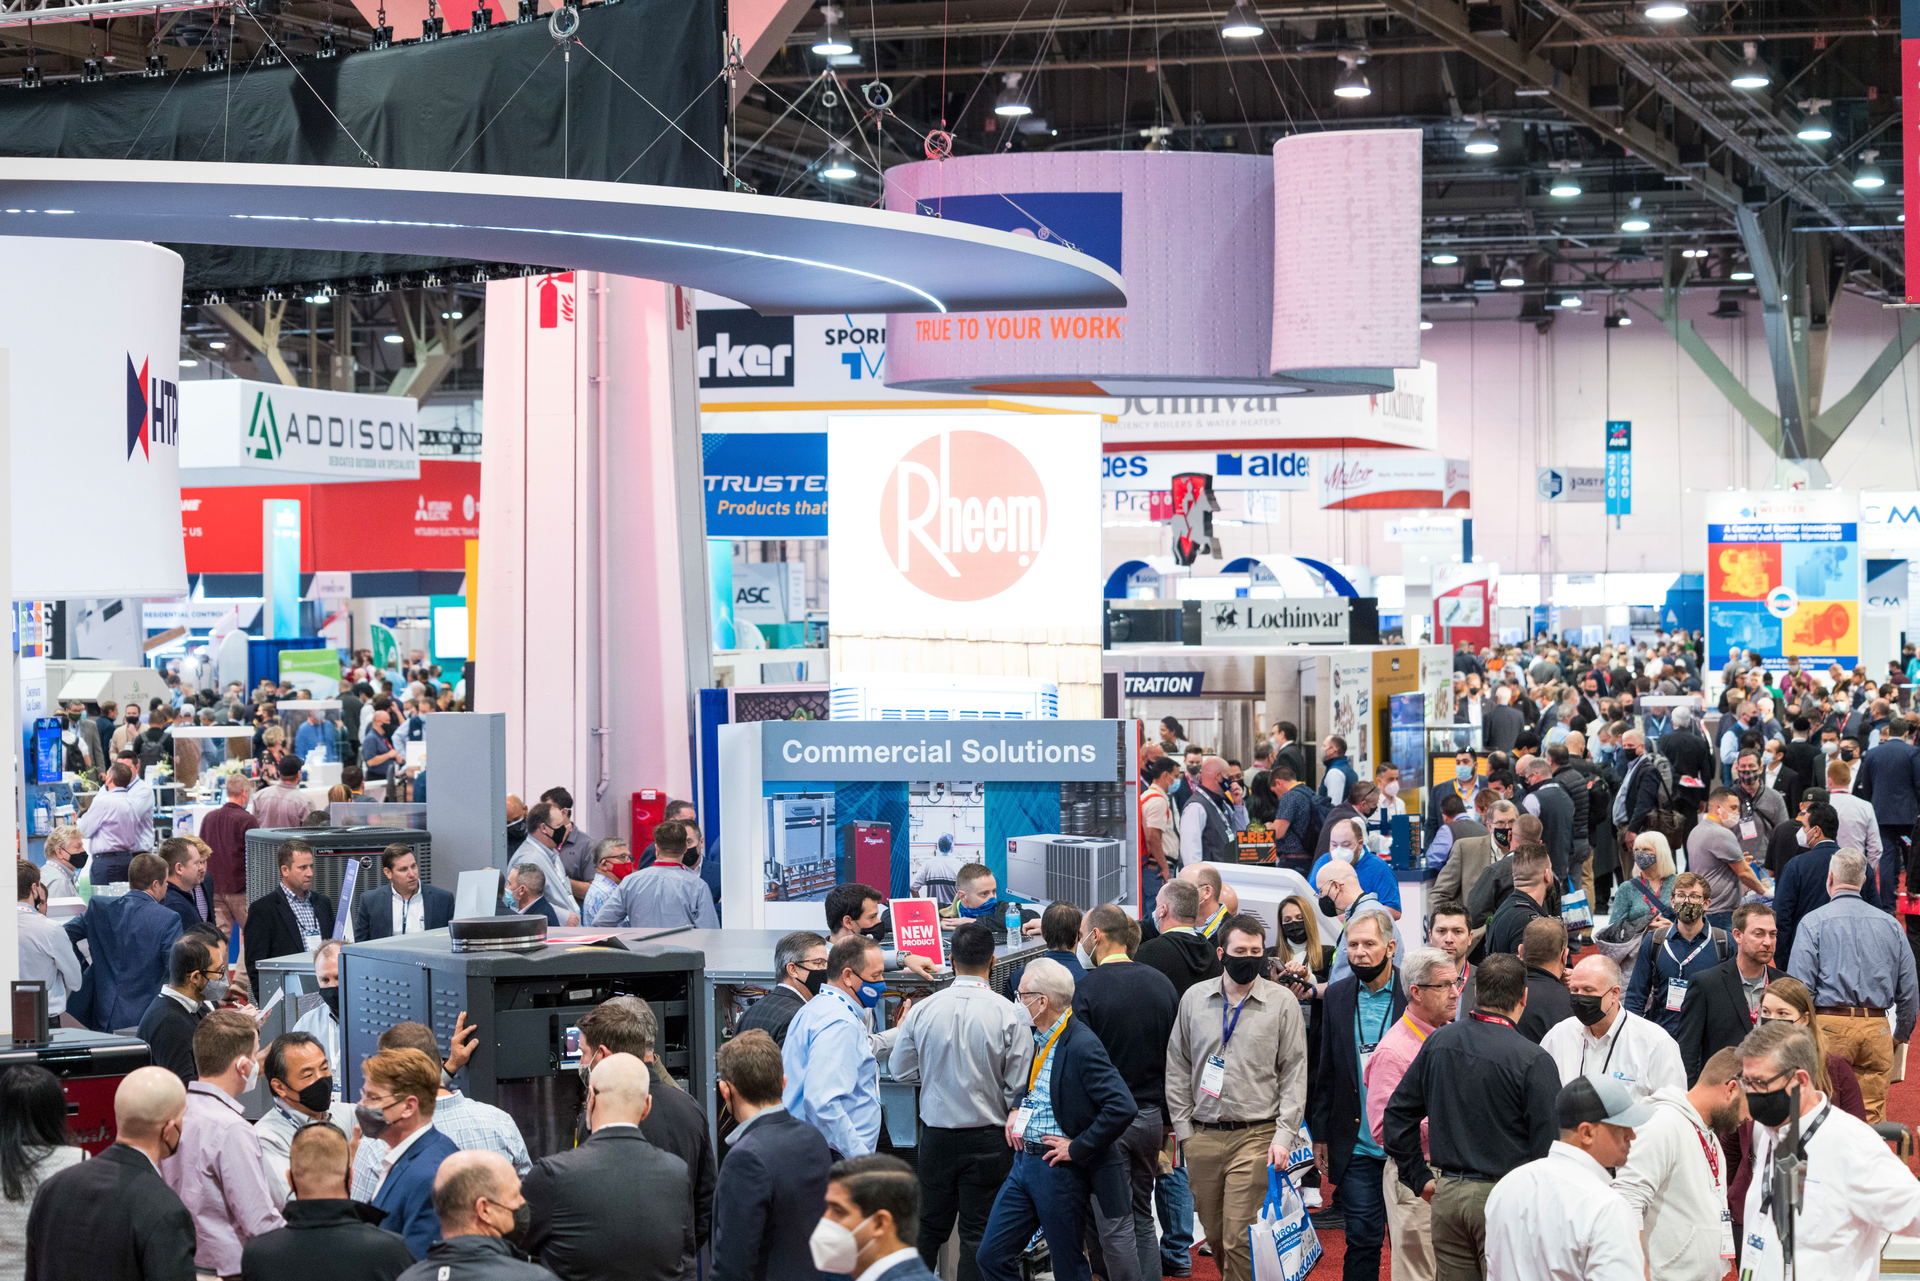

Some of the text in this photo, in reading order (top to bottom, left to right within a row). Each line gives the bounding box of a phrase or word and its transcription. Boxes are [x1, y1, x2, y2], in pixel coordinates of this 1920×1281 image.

[916, 320, 951, 341] TRUE
[957, 318, 979, 340] TO
[986, 317, 1041, 339] YOUR
[286, 413, 414, 451] ADDISON
[703, 475, 828, 492] TRUSTE
[1324, 461, 1374, 492] Malco
[717, 500, 828, 515] Products that
[898, 431, 1042, 577] Rheem
[735, 587, 770, 604] ASC
[1247, 606, 1343, 629] Lochinvar
[783, 739, 1096, 763] Commercial Solutions
[1237, 831, 1275, 844] T-REX
[901, 925, 934, 939] NEW
[902, 939, 935, 947] PRODUCT
